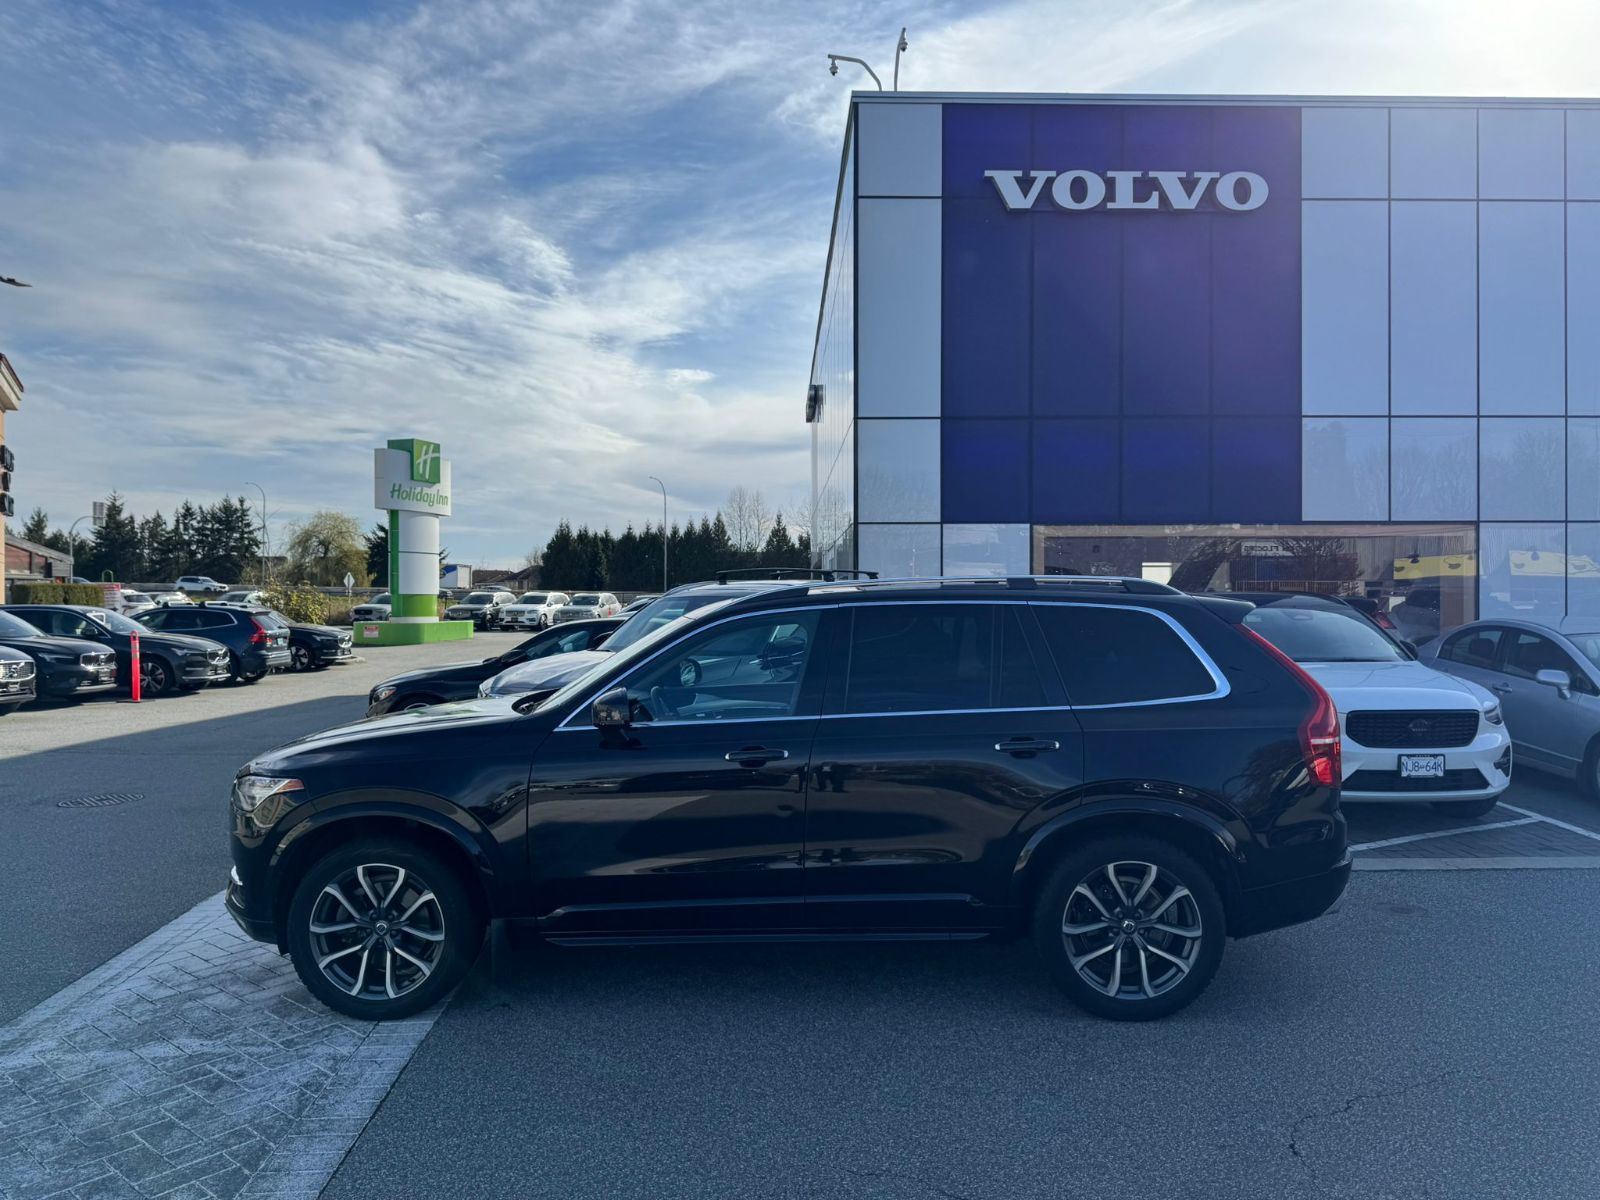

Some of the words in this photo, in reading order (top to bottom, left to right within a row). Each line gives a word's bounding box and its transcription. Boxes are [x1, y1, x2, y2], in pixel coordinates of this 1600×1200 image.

[983, 170, 1269, 211] VOLVO
[390, 482, 436, 508] Holiday
[435, 488, 449, 507] Inn
